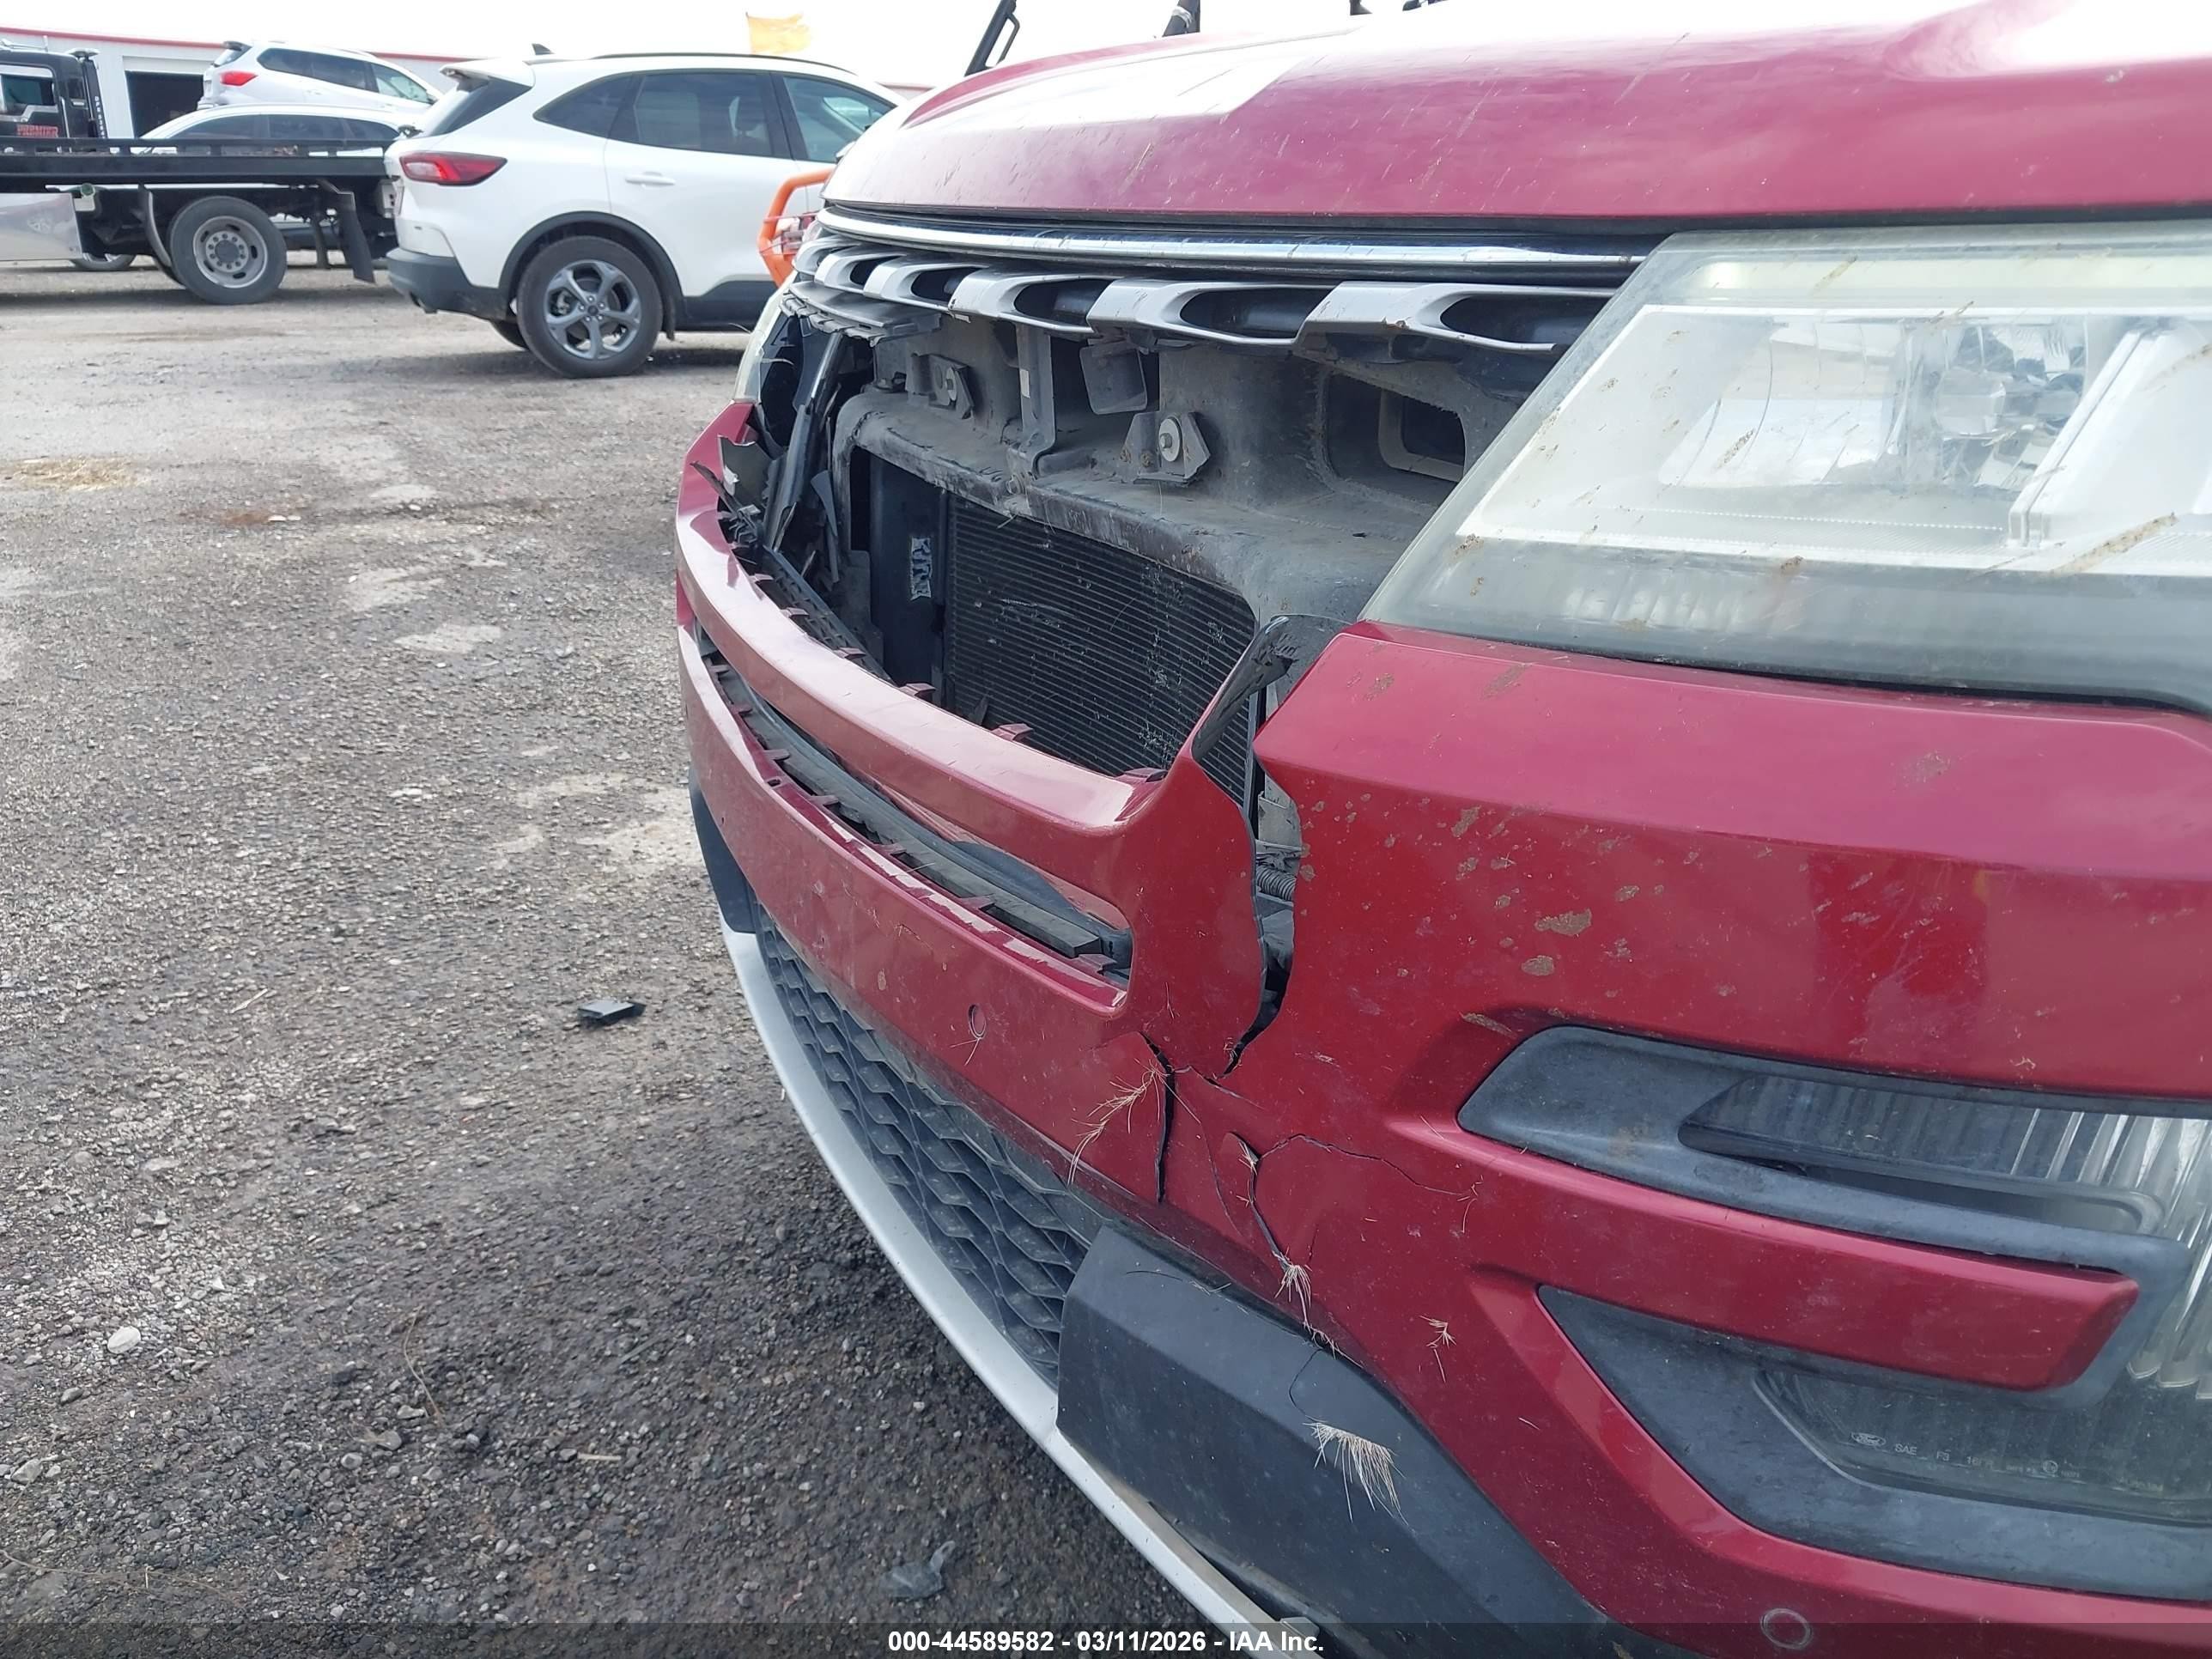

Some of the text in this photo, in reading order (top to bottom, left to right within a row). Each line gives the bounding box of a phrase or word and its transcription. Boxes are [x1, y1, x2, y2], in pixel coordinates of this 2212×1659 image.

[1852, 1432, 1884, 1446] Ford
[1894, 1443, 1917, 1455] SAE
[1936, 1450, 1950, 1462] F3
